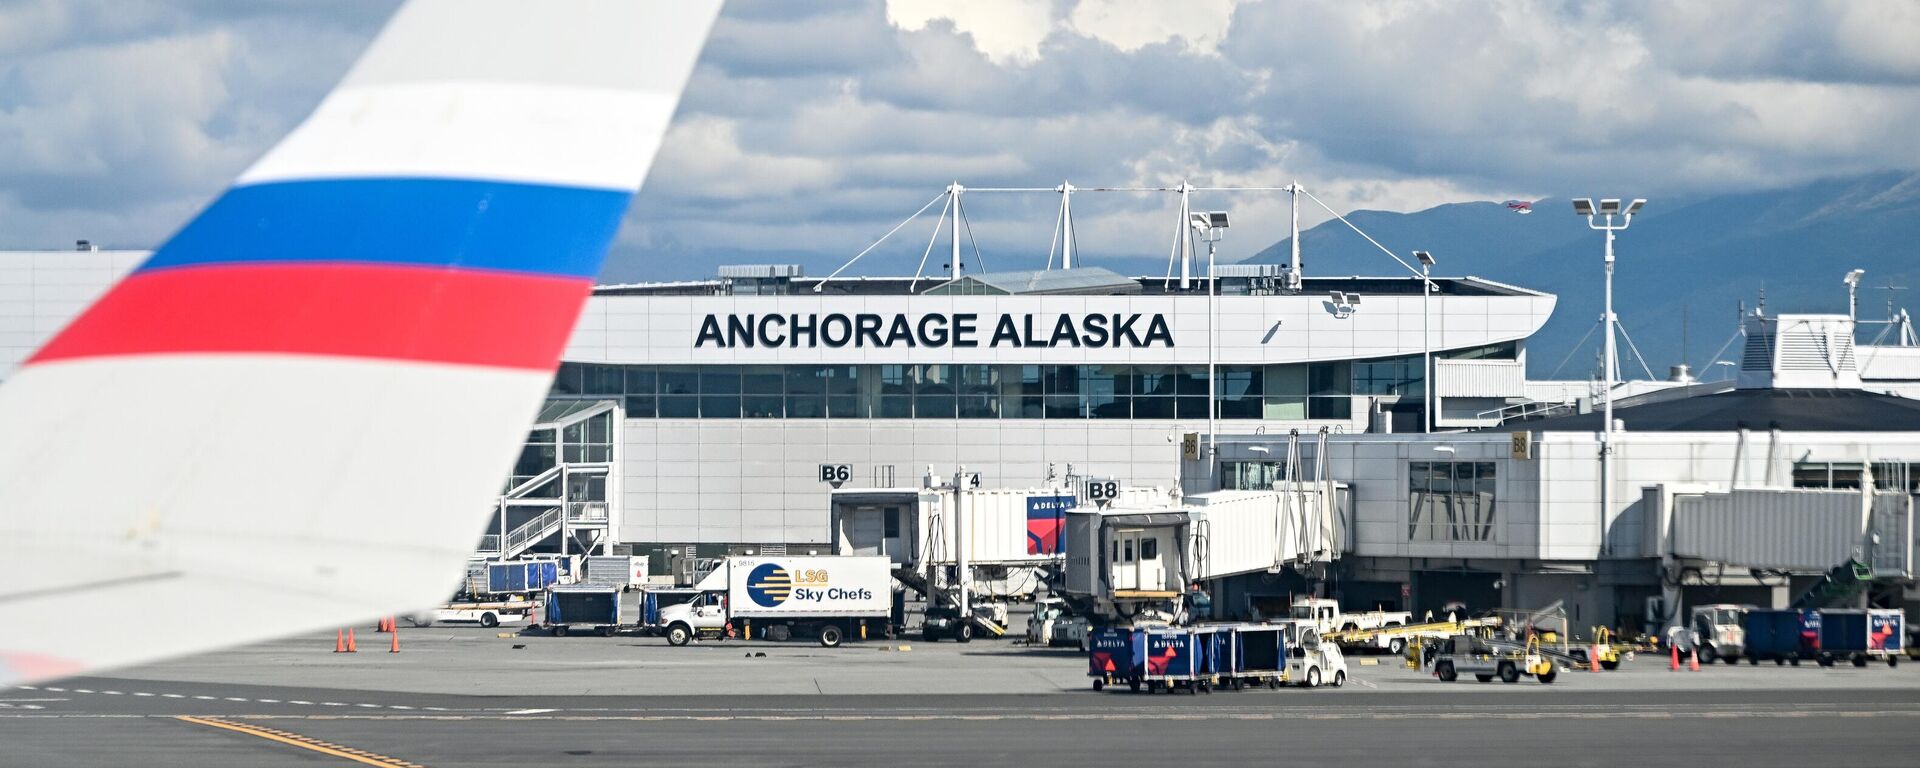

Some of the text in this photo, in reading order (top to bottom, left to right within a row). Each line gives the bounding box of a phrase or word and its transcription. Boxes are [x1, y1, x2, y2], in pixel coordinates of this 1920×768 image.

[694, 313, 1174, 348] ANCHORAGE ALASKA
[1185, 440, 1195, 454] B6
[822, 465, 850, 481] B6
[970, 475, 980, 488] 4
[1089, 482, 1118, 499] B8
[795, 569, 829, 583] LSG
[795, 588, 872, 602] Sky Chefs
